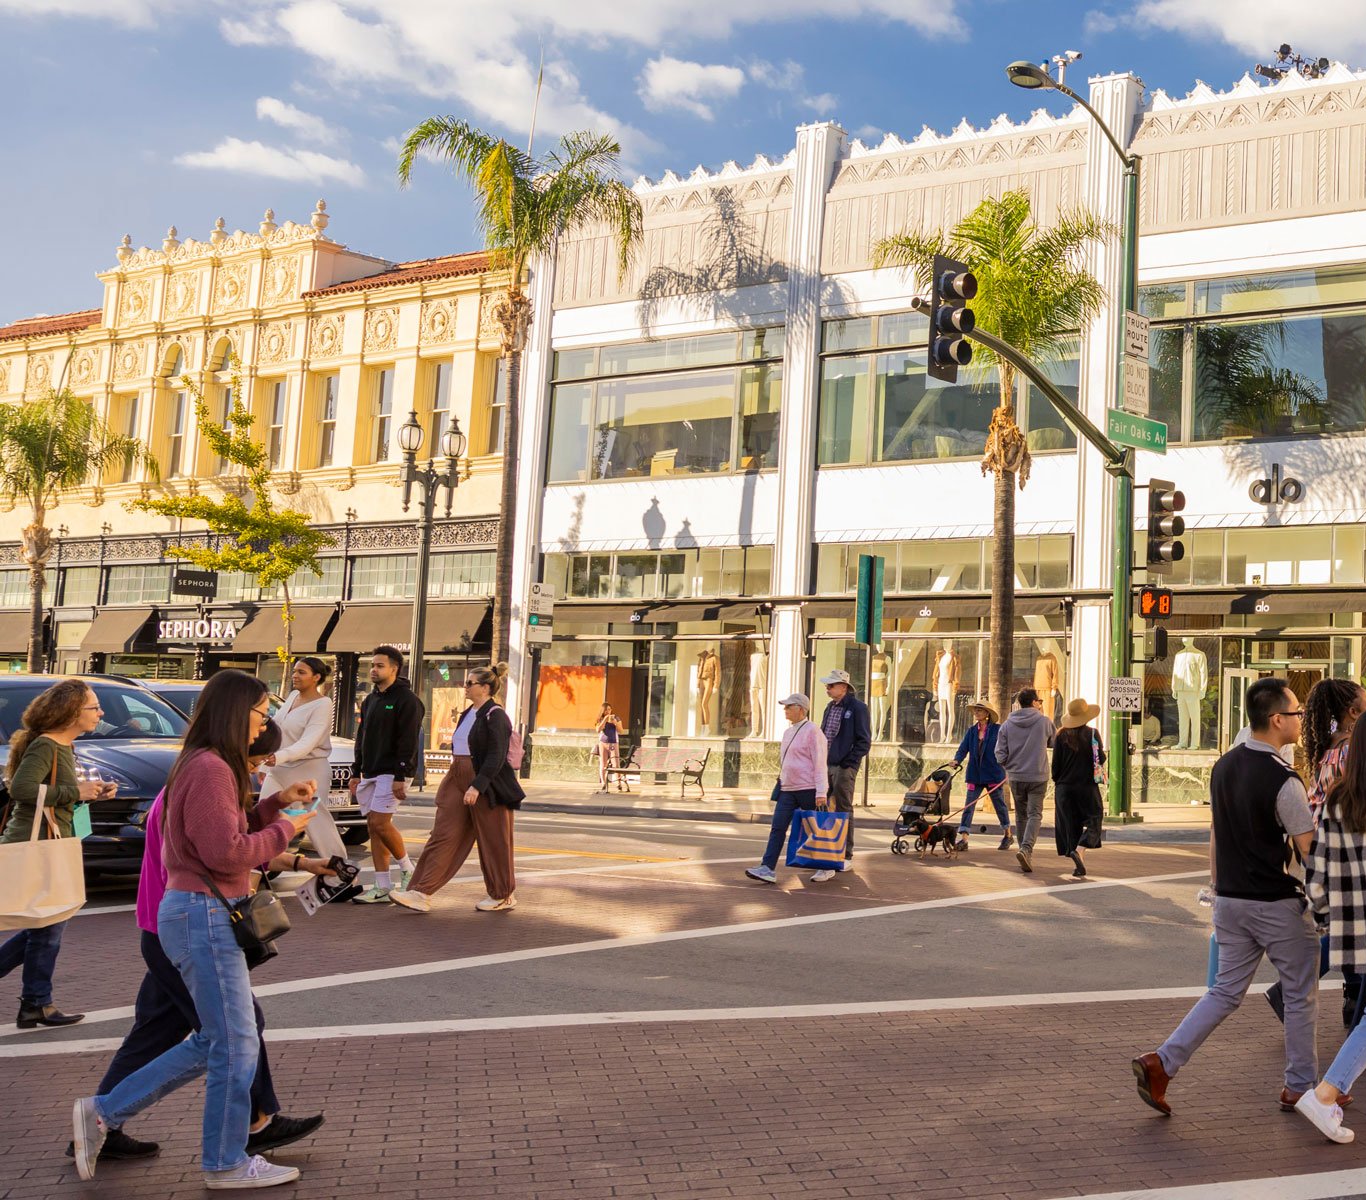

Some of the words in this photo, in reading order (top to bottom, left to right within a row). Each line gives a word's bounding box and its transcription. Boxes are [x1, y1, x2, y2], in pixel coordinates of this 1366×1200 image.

[1127, 317, 1148, 330] TRUCK
[1127, 329, 1148, 344] ROUTE
[1126, 363, 1134, 376] DO
[1137, 365, 1147, 380] NOT
[1127, 381, 1146, 397] BLOCK
[1110, 418, 1127, 435] Fair
[1130, 424, 1152, 441] Oaks
[1155, 431, 1165, 444] Av
[1249, 463, 1302, 505] alo
[178, 579, 215, 588] SEPHORA
[919, 605, 932, 617] alo
[1255, 600, 1270, 612] alo
[631, 611, 641, 621] alo
[159, 619, 237, 639] SEPHORA
[1110, 696, 1121, 707] OK
